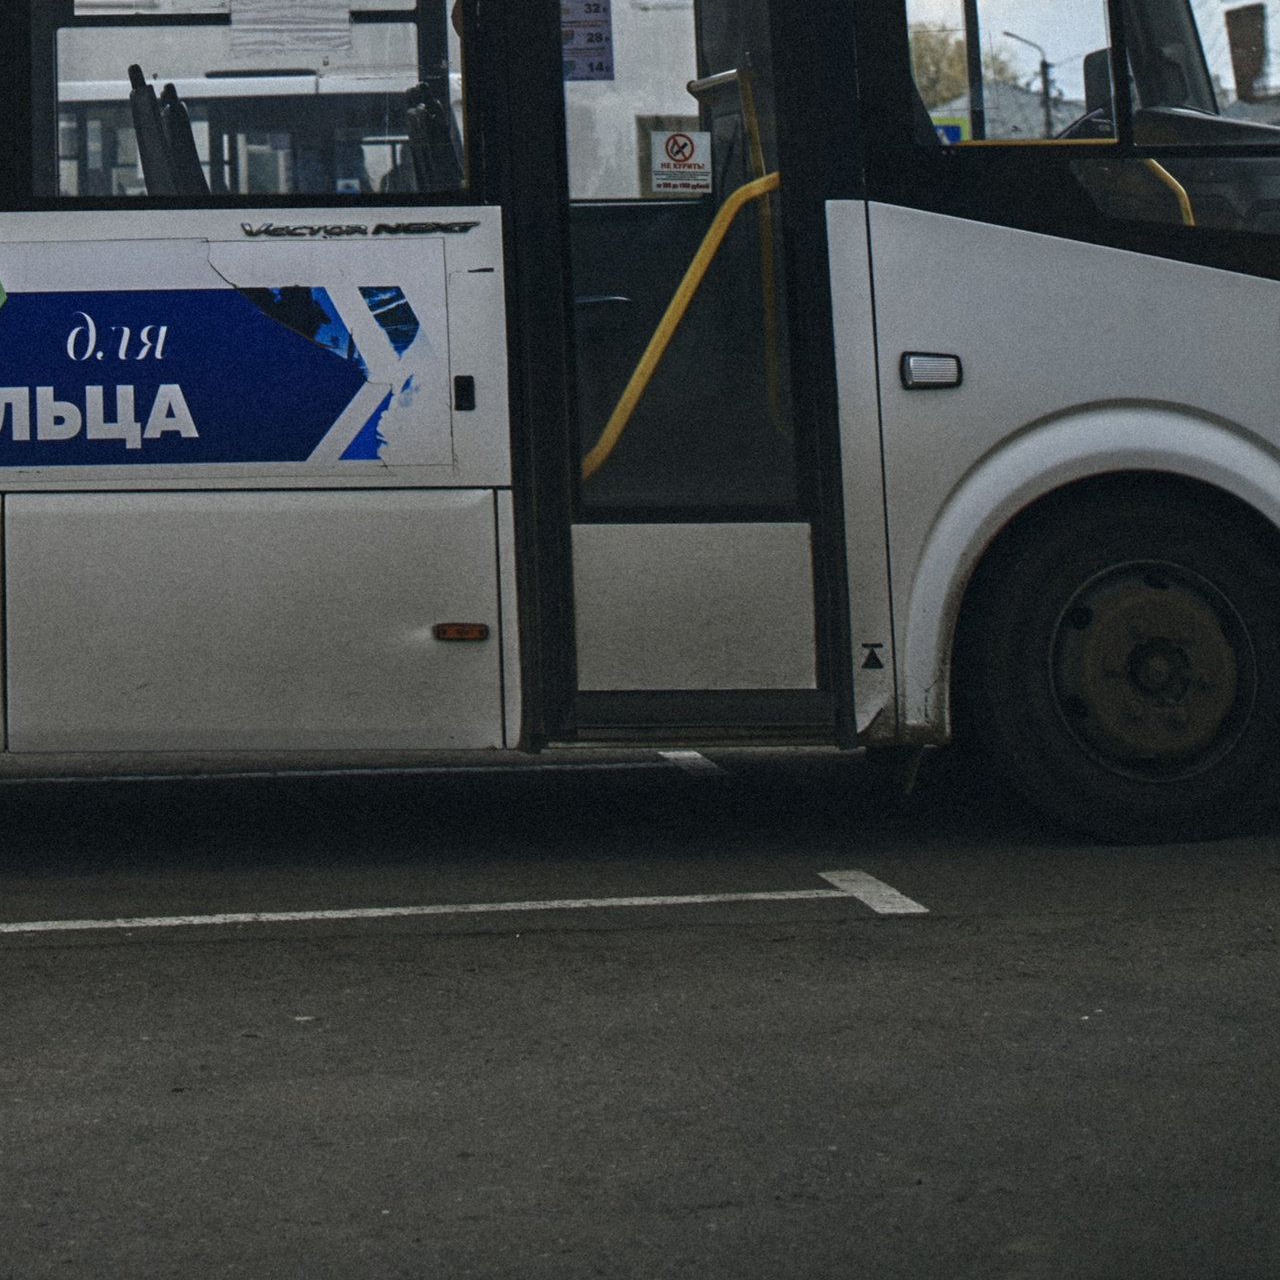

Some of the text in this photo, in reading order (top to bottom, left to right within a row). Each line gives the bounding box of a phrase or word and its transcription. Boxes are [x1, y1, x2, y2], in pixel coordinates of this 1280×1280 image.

[584, 3, 601, 13] 32
[587, 32, 603, 43] 28
[587, 62, 604, 72] 14
[66, 311, 168, 361] для
